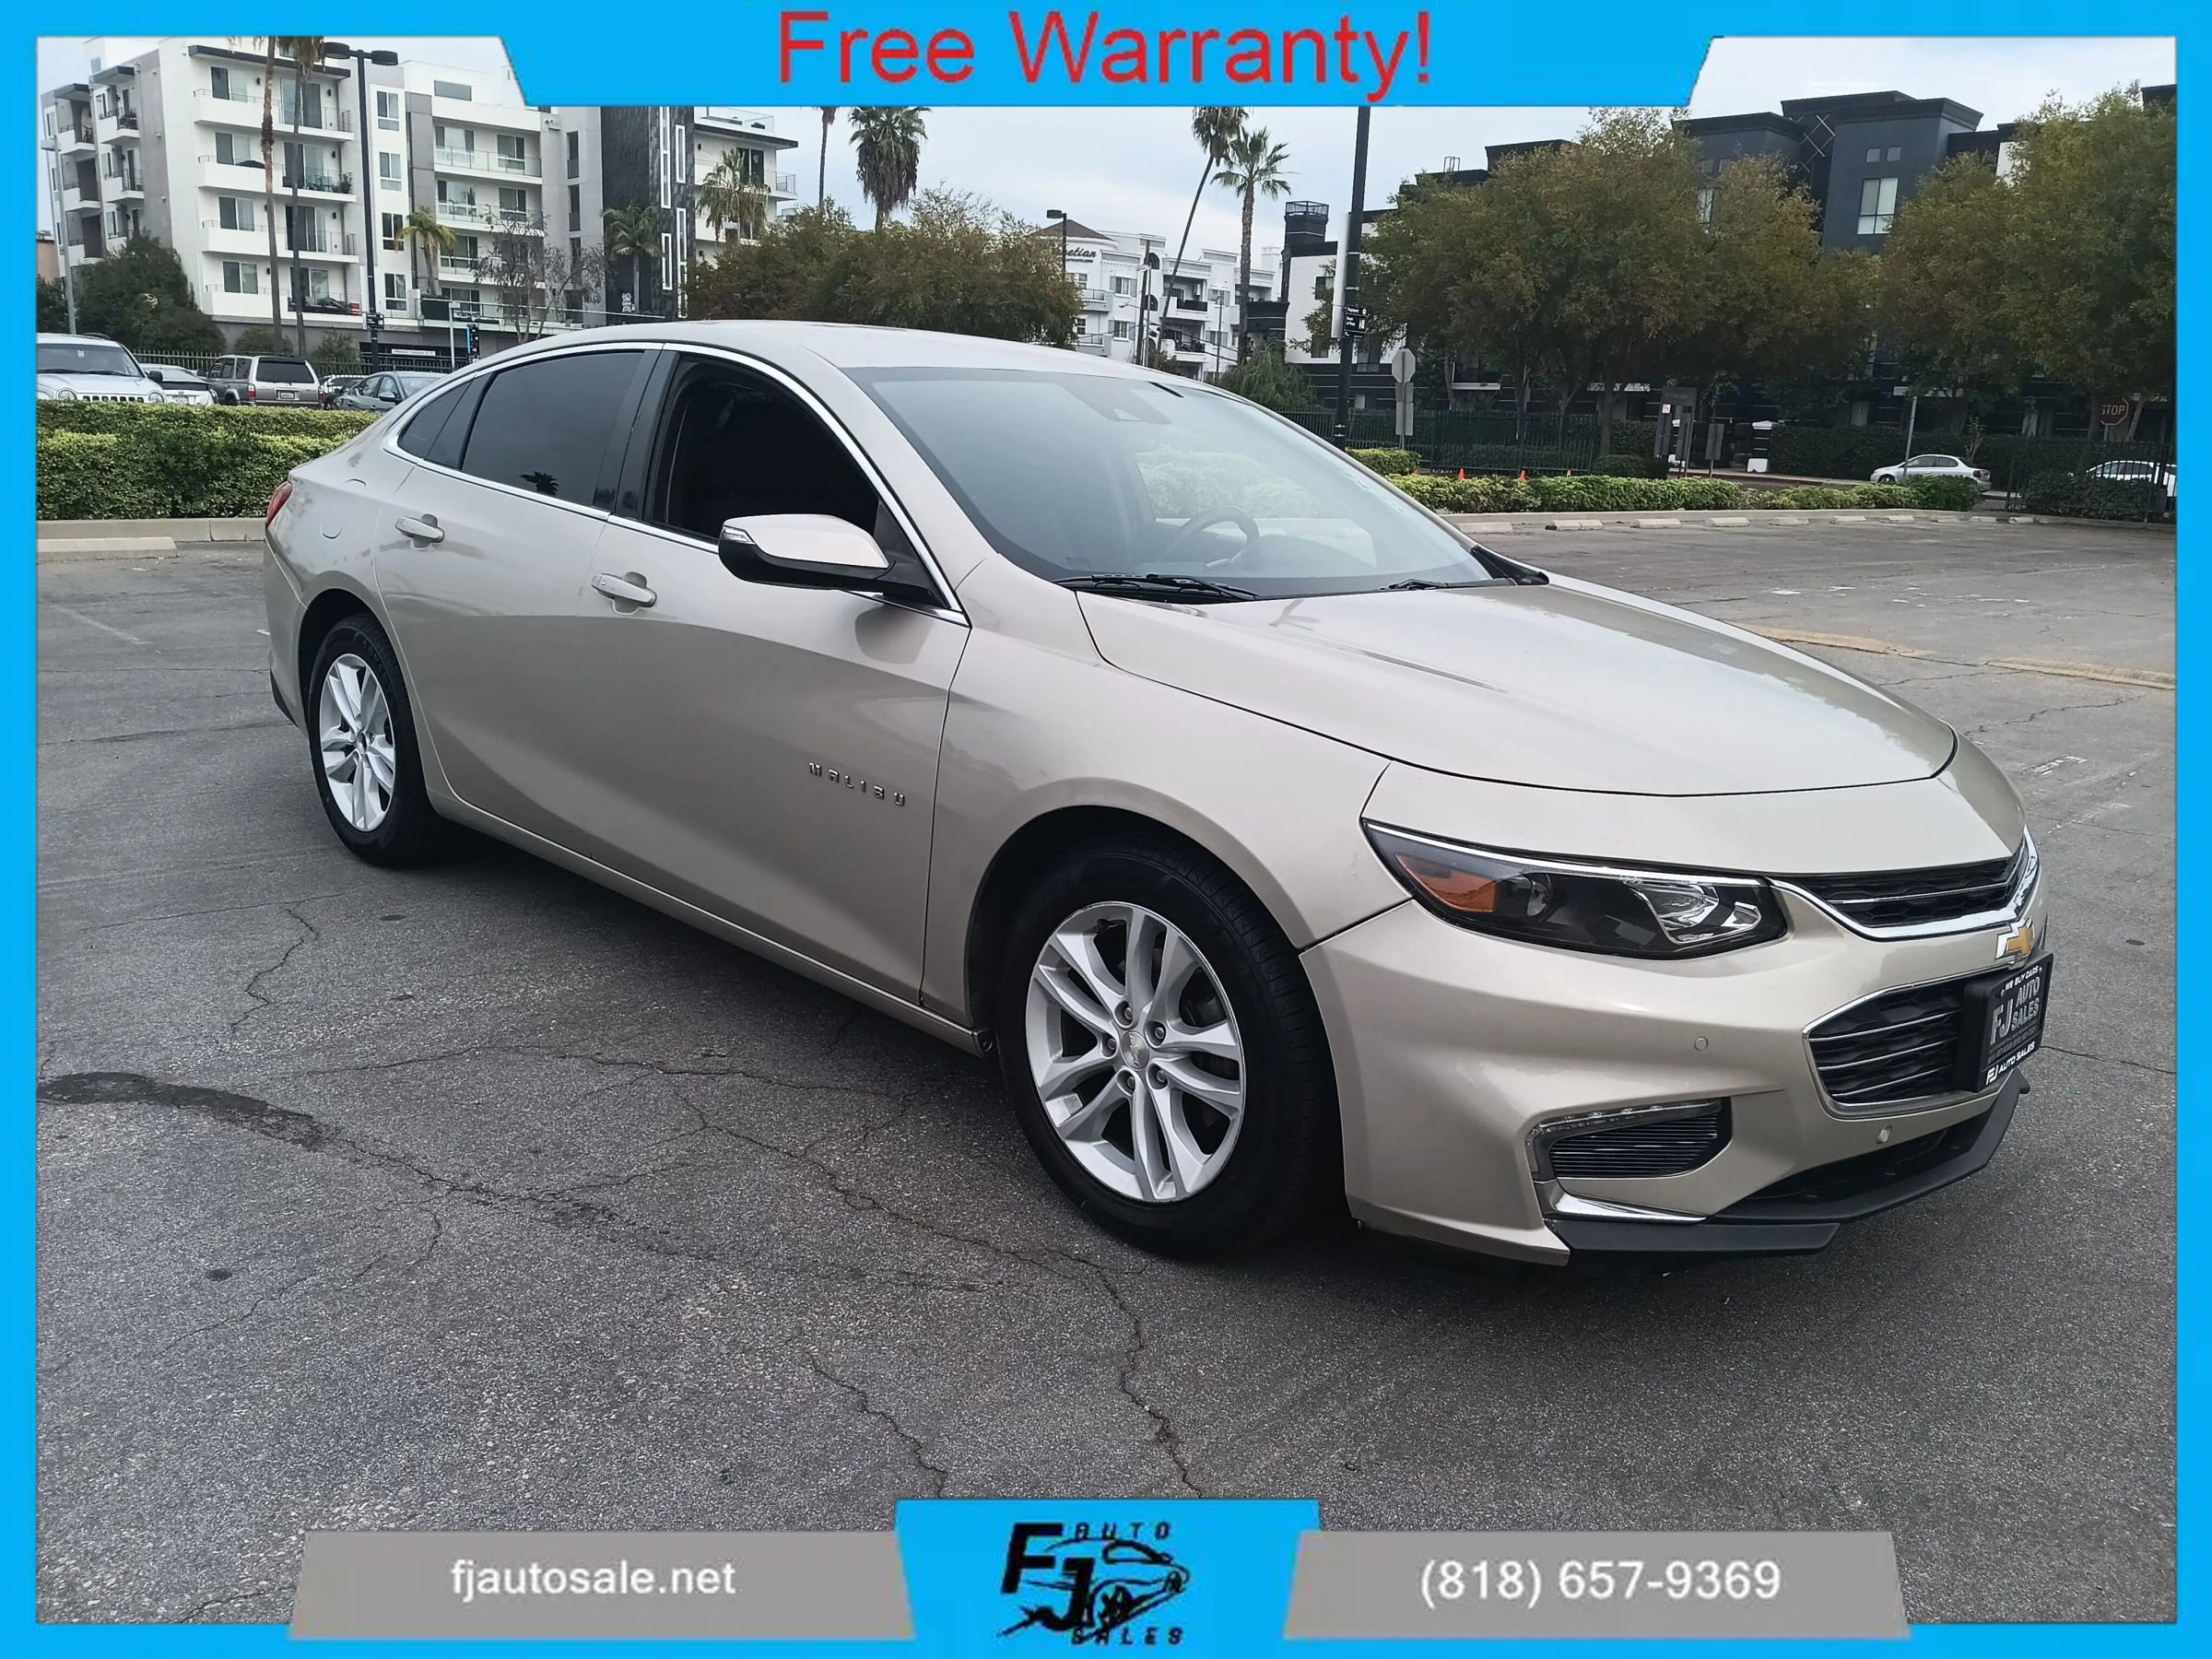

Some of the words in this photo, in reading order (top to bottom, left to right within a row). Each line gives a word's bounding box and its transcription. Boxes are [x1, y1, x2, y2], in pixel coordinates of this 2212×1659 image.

[2101, 405, 2126, 416] STOP
[808, 761, 906, 807] MALIBU
[2014, 972, 2026, 986] BUY
[2025, 965, 2040, 980] CARS
[2016, 976, 2041, 1008] AUTO
[1990, 998, 2014, 1046] FJ
[2011, 997, 2040, 1031] SALES
[1985, 1064, 1999, 1086] FJ
[1998, 1055, 2017, 1074] AUTO
[2016, 1041, 2036, 1062] SALES
